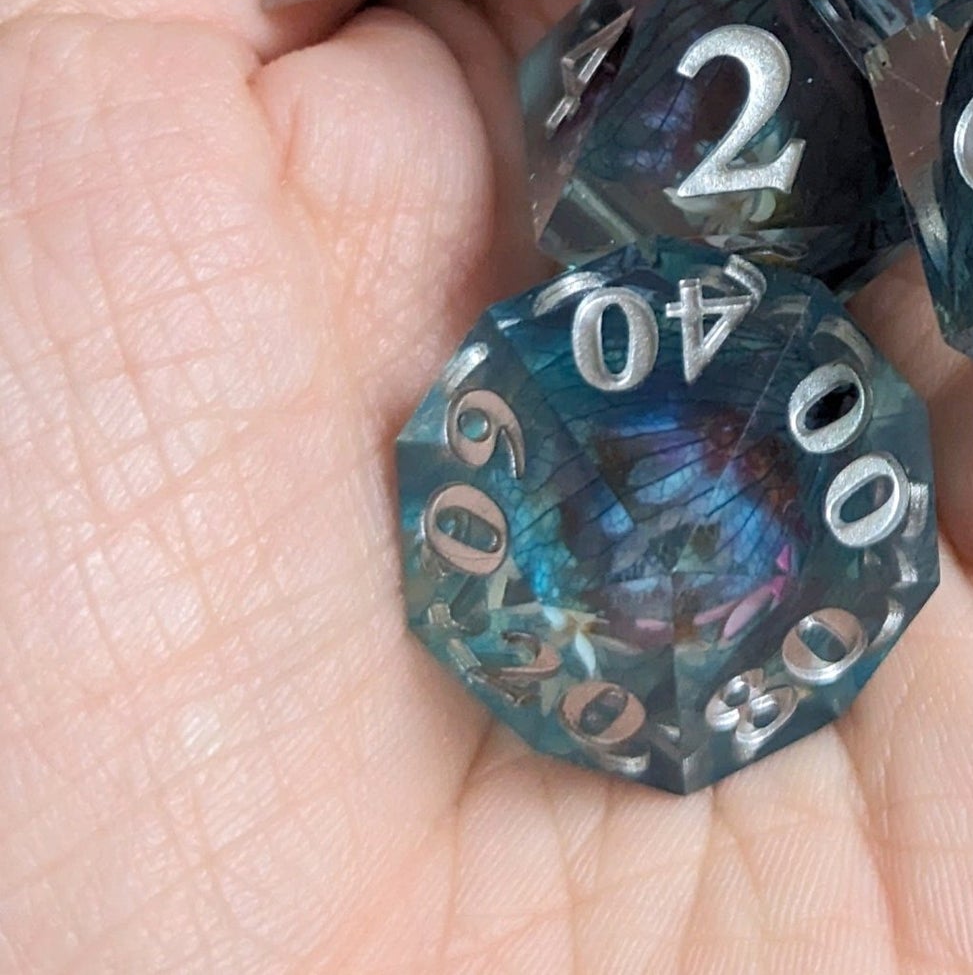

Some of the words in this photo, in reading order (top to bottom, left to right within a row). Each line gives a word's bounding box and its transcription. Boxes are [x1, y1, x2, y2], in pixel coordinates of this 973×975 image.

[676, 22, 807, 198] 2
[571, 277, 758, 392] 40
[788, 361, 912, 549] 00
[705, 606, 870, 746] 80
